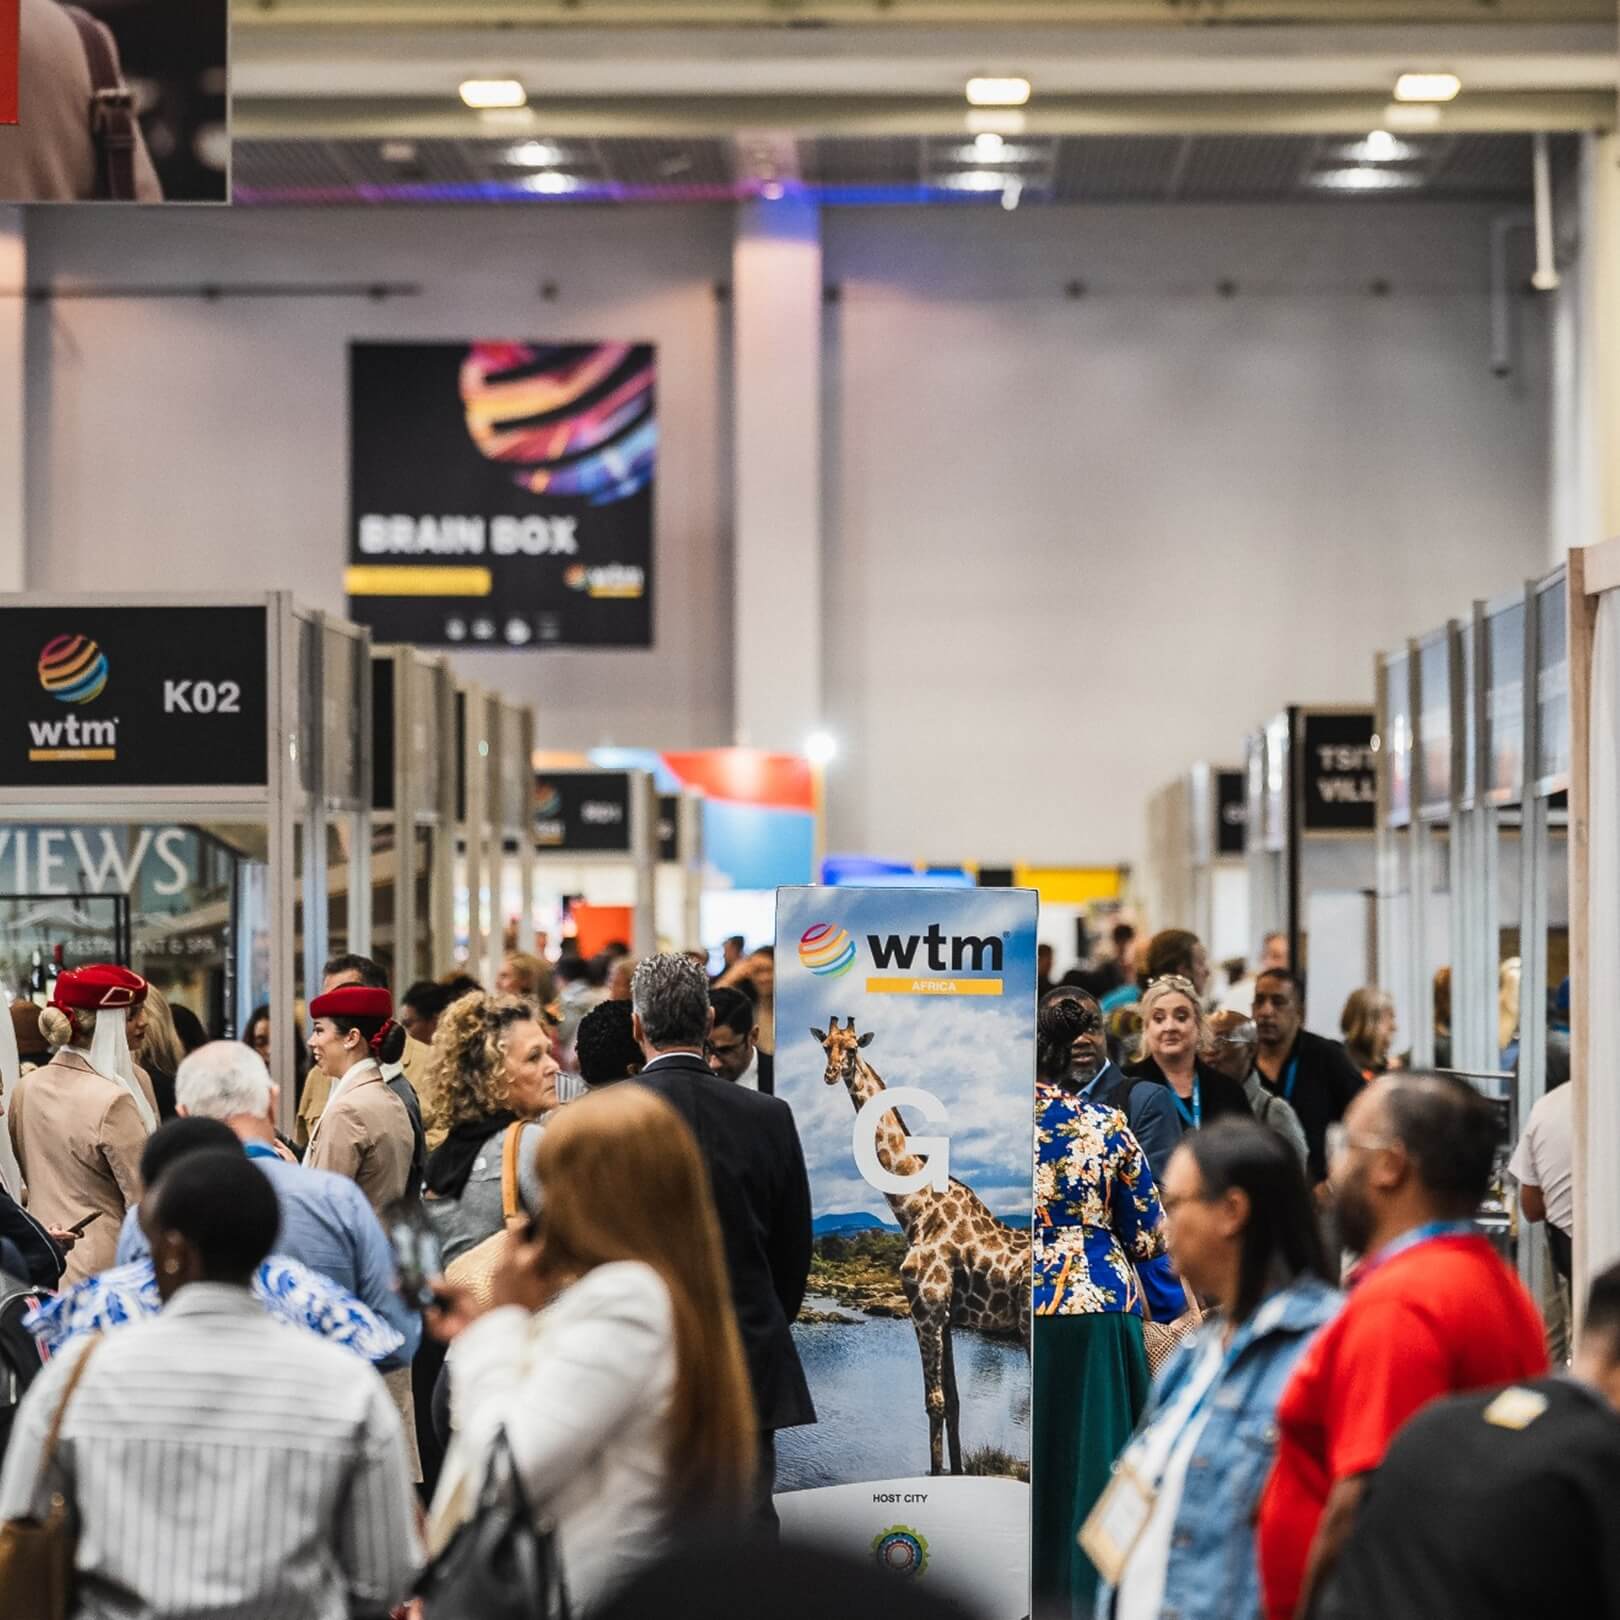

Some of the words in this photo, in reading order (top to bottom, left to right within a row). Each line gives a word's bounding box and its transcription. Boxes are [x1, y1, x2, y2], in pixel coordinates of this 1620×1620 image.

[359, 514, 487, 555] BRAIN
[490, 515, 578, 556] BOX
[163, 680, 240, 713] K02
[911, 980, 957, 992] AFRICA
[853, 1086, 950, 1195] G
[872, 1493, 902, 1504] HOST
[903, 1493, 929, 1504] CITY
